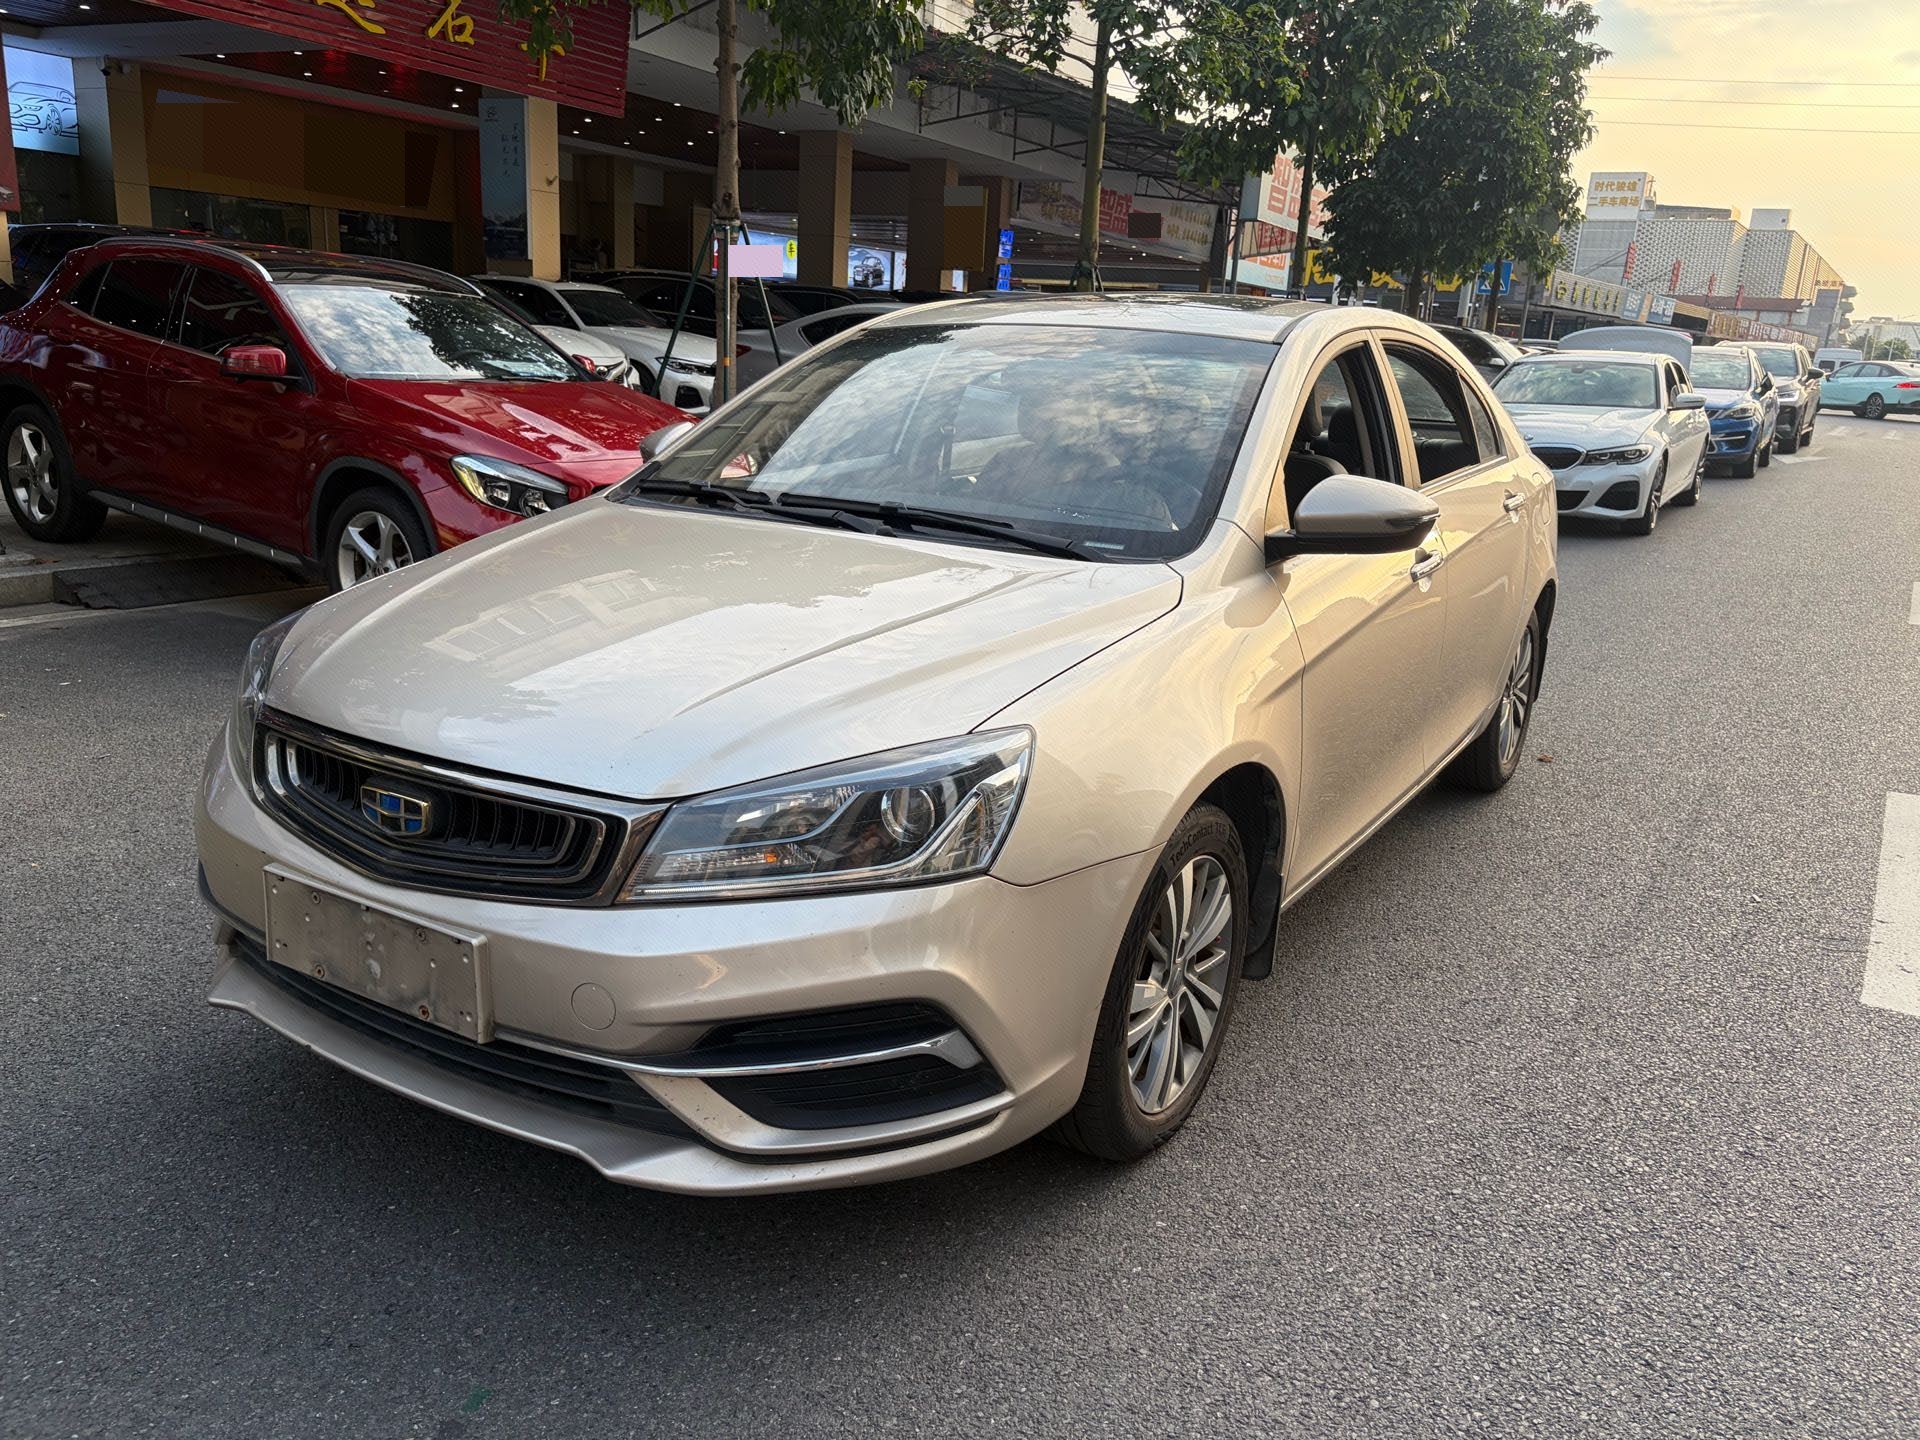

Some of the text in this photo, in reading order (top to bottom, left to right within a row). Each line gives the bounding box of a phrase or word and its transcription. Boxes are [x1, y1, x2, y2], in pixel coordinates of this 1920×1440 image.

[1587, 196, 1640, 207] 二手车商场
[1169, 823, 1213, 867] TechContact
